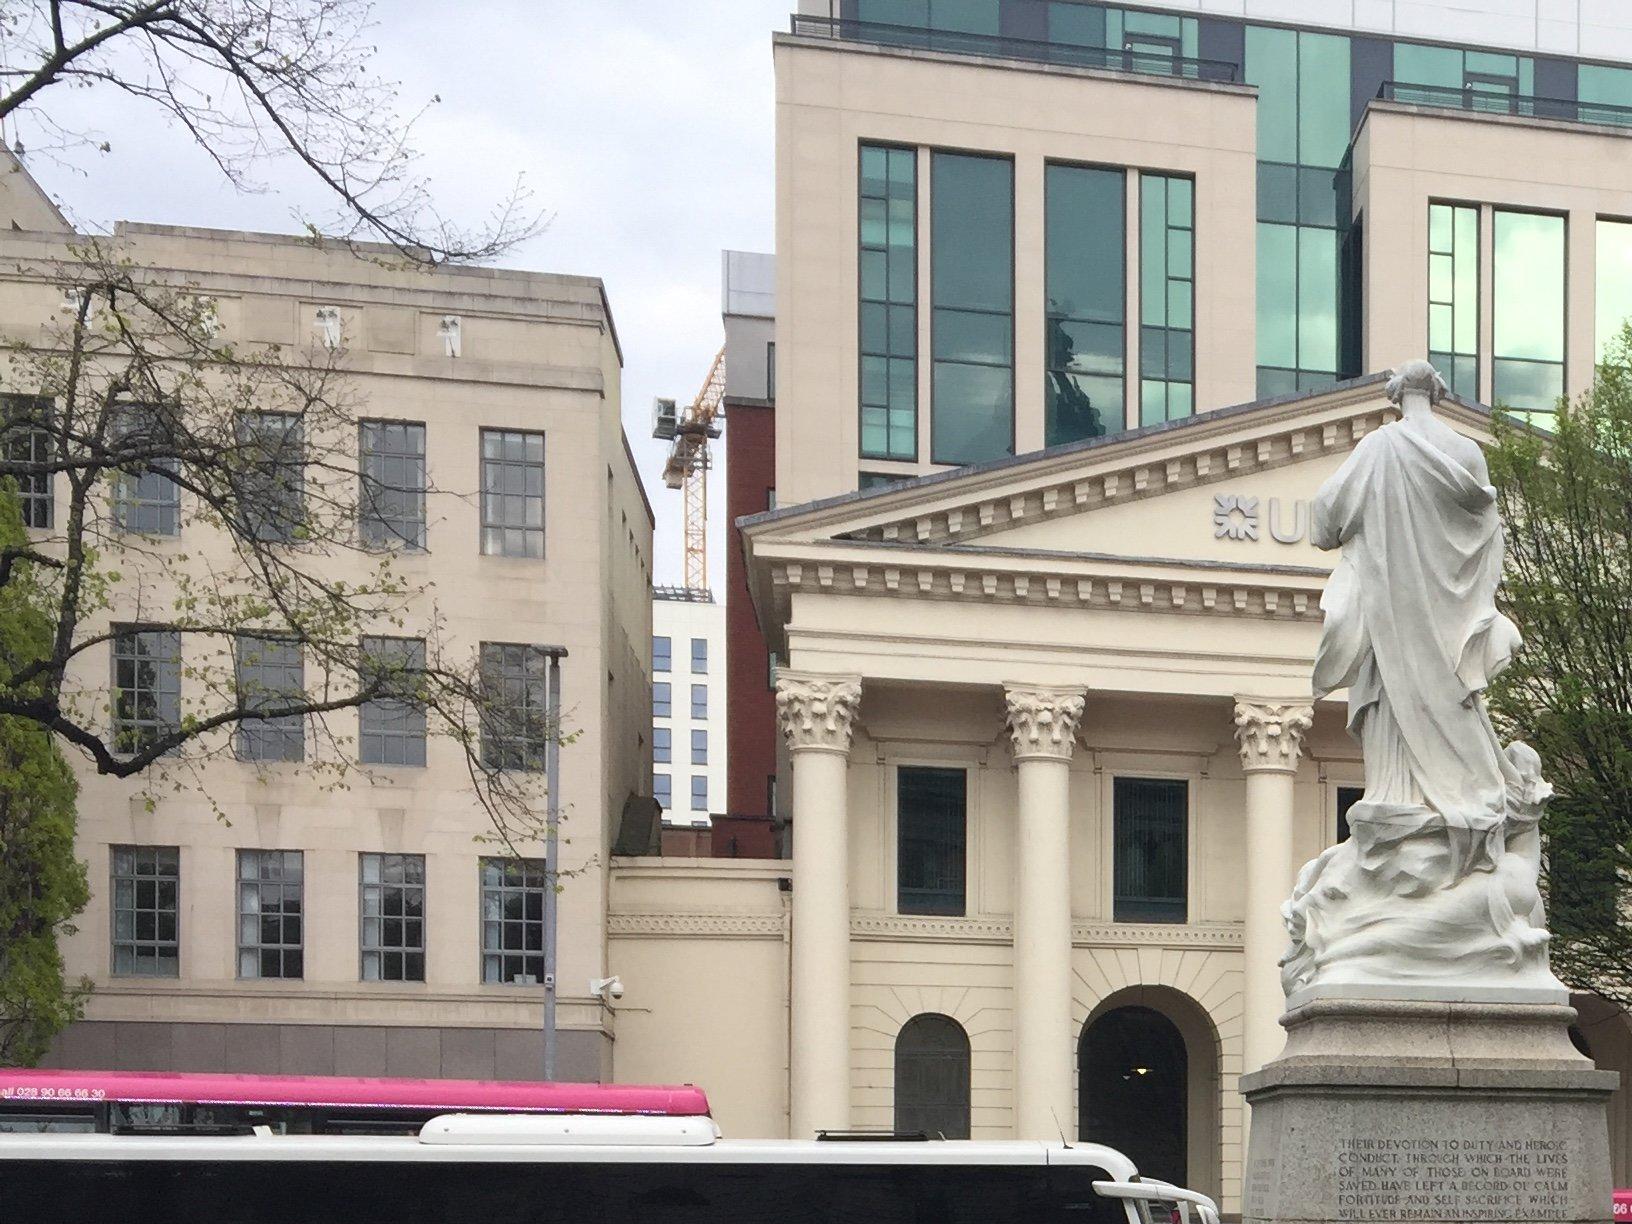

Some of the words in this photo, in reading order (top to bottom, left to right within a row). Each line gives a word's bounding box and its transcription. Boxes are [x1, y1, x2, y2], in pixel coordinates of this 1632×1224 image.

[16, 1087, 38, 1097] 028
[40, 1087, 55, 1098] 90
[57, 1088, 72, 1098] 66
[74, 1088, 89, 1098] 66
[91, 1088, 106, 1099] 30
[1340, 1138, 1375, 1150] THEIR
[1377, 1138, 1439, 1150] DEVOTION
[1443, 1138, 1459, 1150] TO
[1463, 1138, 1493, 1150] DUTY
[1498, 1138, 1522, 1150] AND
[1405, 1152, 1460, 1164] THROUGH
[1464, 1152, 1502, 1164] WHICH
[1508, 1152, 1530, 1164] THE
[1536, 1152, 1569, 1164] LIVES
[1338, 1166, 1354, 1178] OF
[1362, 1166, 1397, 1178] MANY
[1402, 1166, 1418, 1178] OF
[1427, 1166, 1464, 1178] THOSE
[1471, 1166, 1489, 1178] ON
[1493, 1166, 1531, 1178] BOARD
[1536, 1166, 1568, 1178] WERE
[1338, 1180, 1377, 1191] SAVED
[1381, 1180, 1412, 1191] HAVE
[1415, 1180, 1444, 1191] LEFT
[1448, 1180, 1457, 1191] A
[1461, 1180, 1509, 1191] RECORD
[1534, 1180, 1569, 1191] CALM
[1338, 1194, 1401, 1205] FORTITUDE
[1406, 1194, 1430, 1205] AND
[1434, 1194, 1460, 1205] SELF
[1465, 1194, 1521, 1205] SACRIFICE
[1529, 1194, 1569, 1205] WHICH
[1338, 1208, 1366, 1219] WILL
[1368, 1208, 1397, 1219] EVER
[1400, 1208, 1442, 1219] REMAIN
[1444, 1208, 1460, 1219] AN
[1515, 1208, 1568, 1219] EXAMPLE
